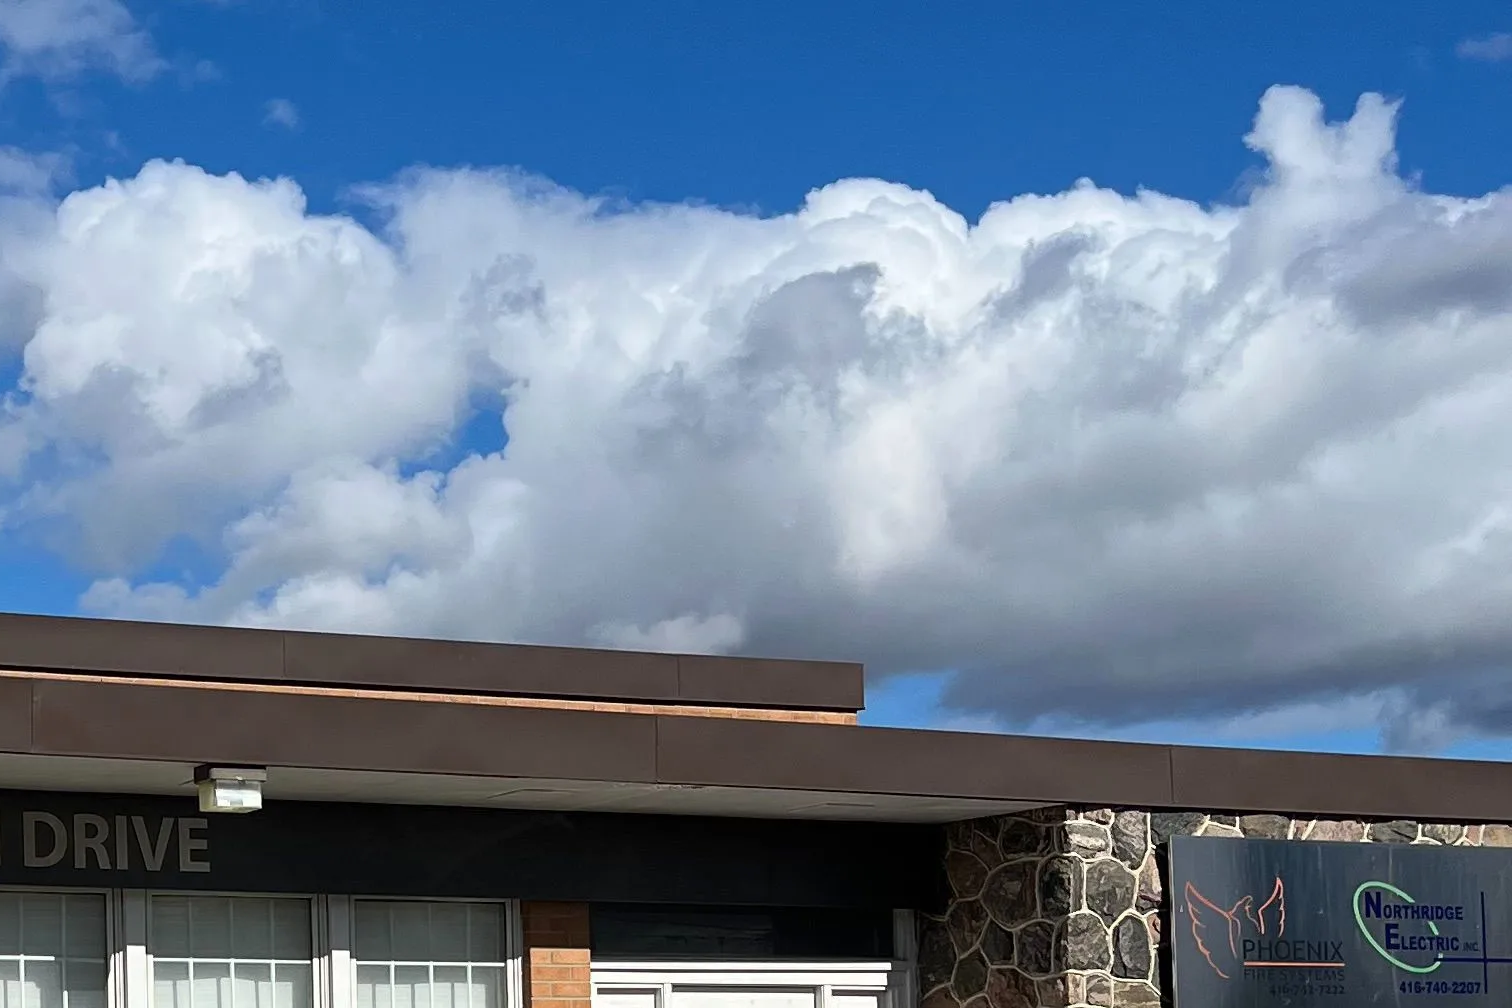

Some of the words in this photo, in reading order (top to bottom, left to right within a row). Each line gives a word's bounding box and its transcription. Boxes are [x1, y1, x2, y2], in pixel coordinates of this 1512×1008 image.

[22, 811, 212, 873] DRIVE
[1242, 939, 1345, 961] PHOENIX
[1243, 968, 1275, 981] FIRE
[1399, 981, 1481, 995] 416-740-2207
